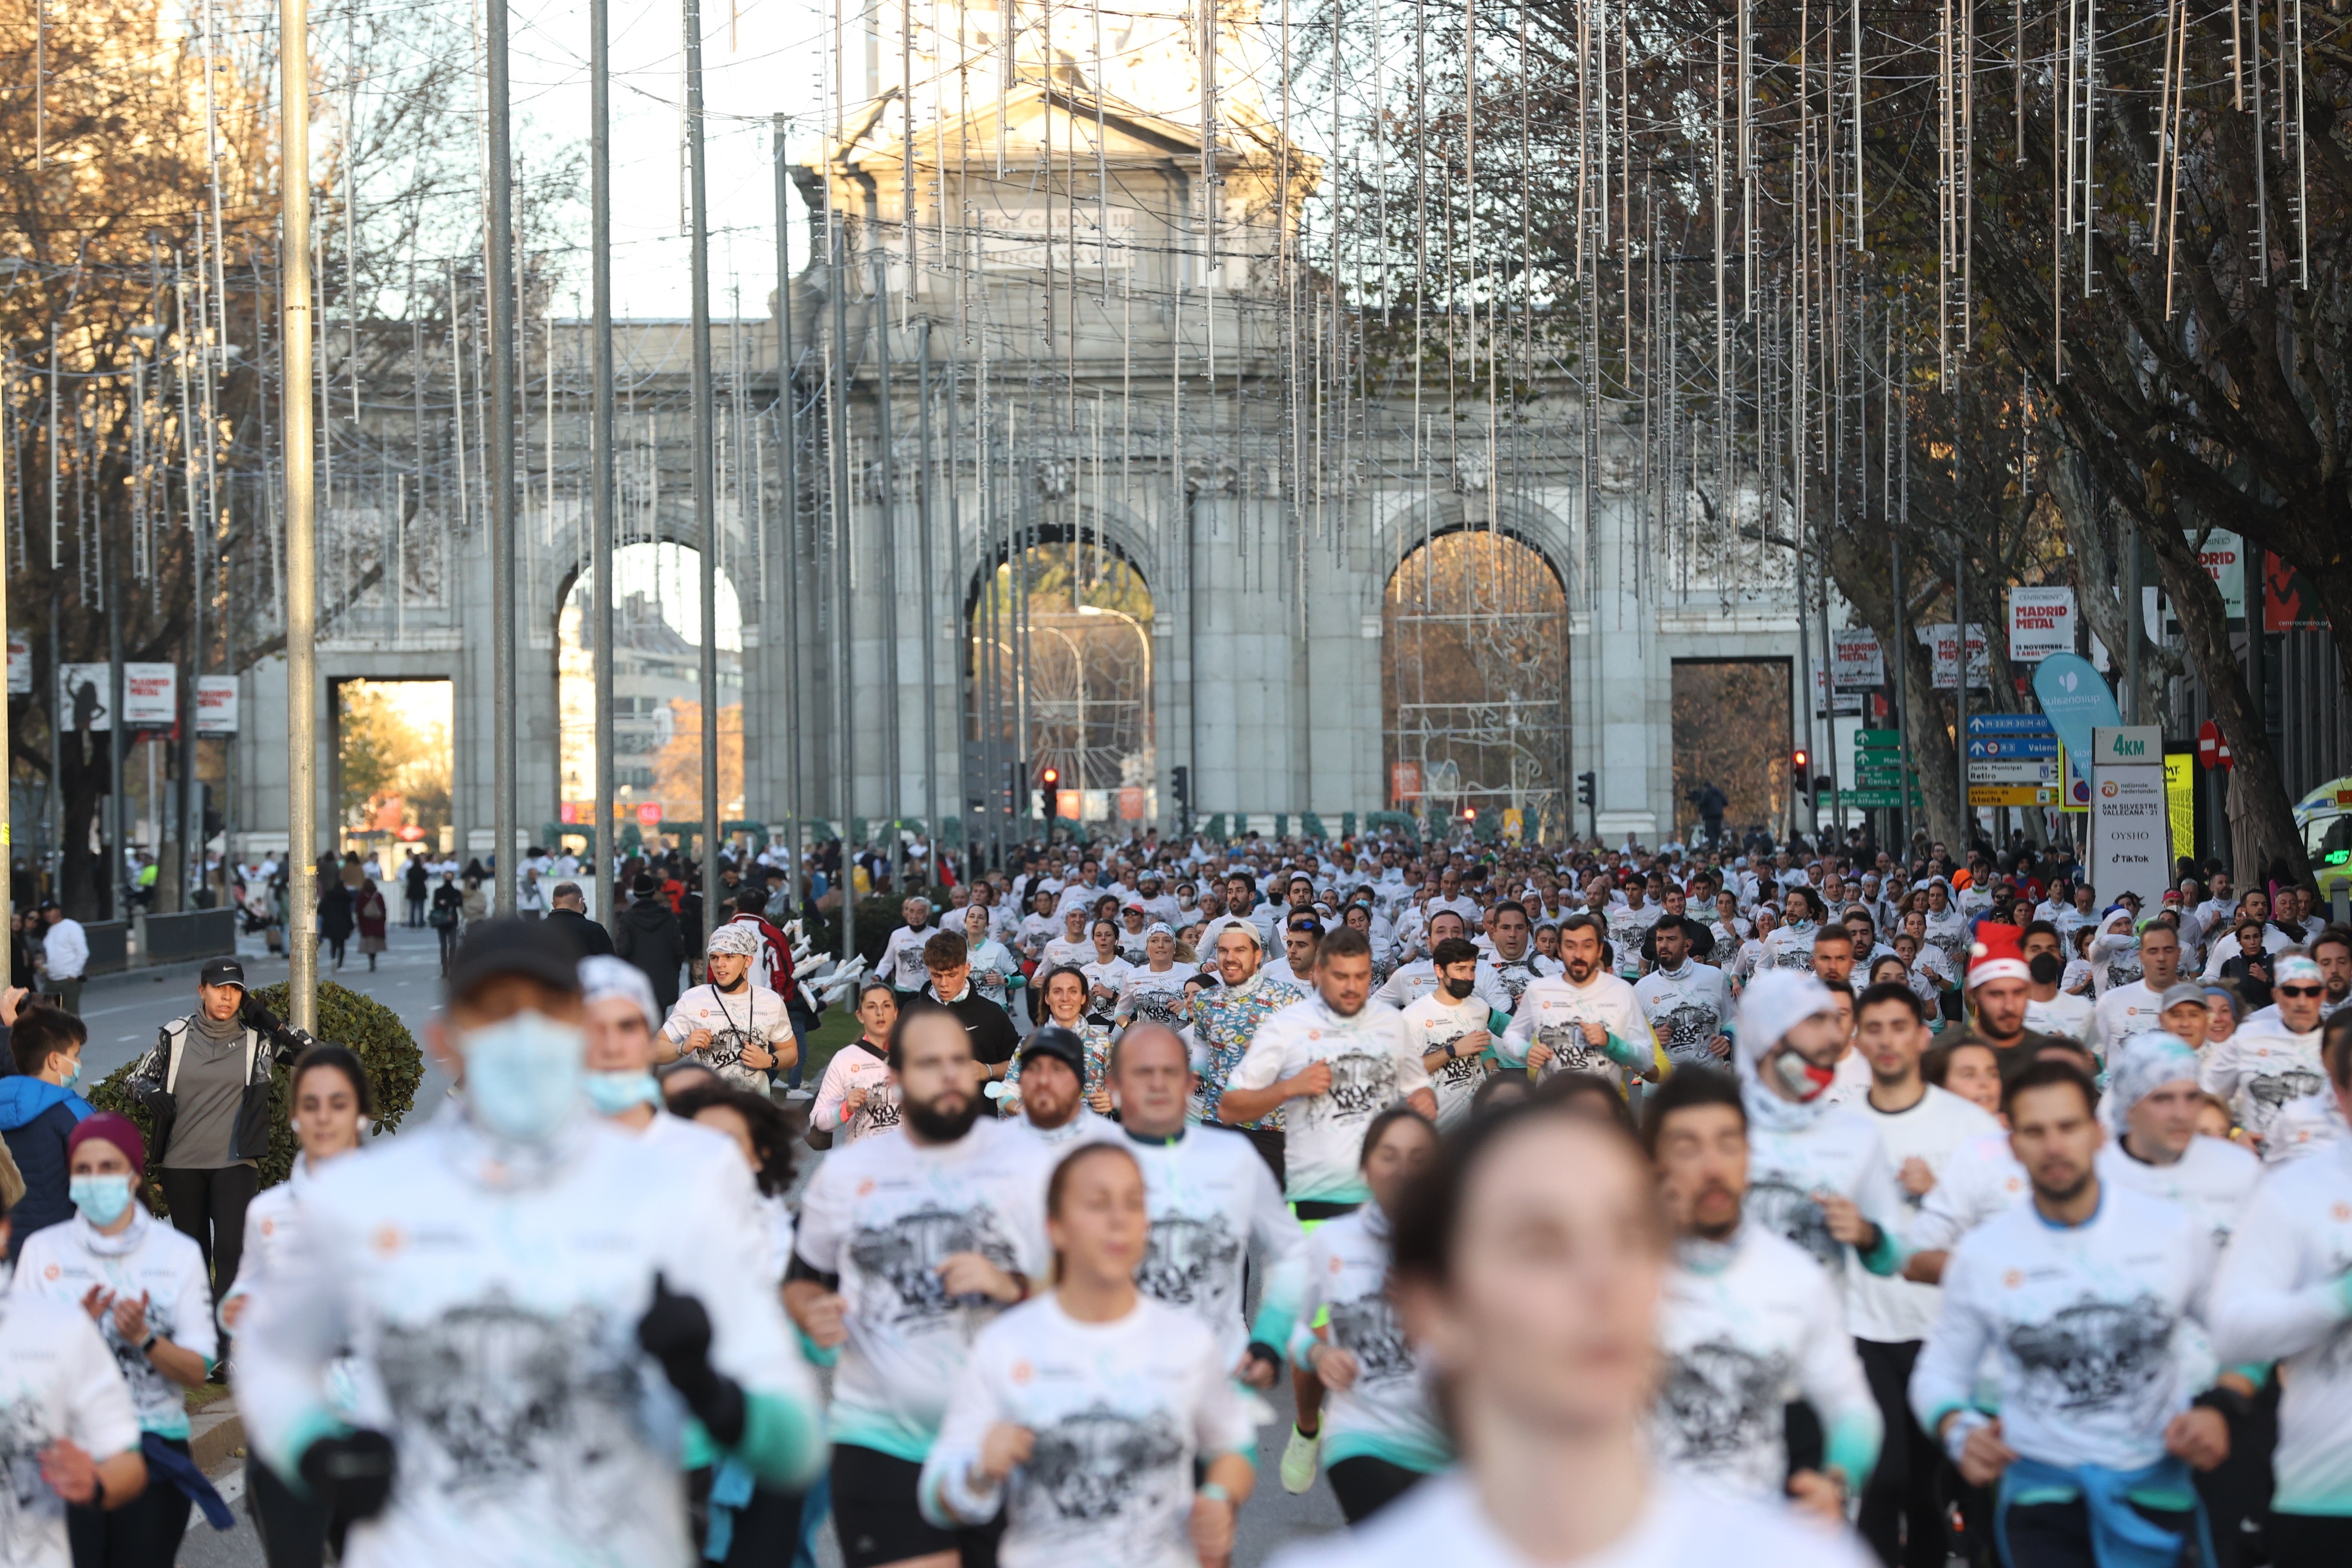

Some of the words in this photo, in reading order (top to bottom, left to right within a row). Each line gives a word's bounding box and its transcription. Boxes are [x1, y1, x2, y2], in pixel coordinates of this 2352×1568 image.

[2198, 552, 2236, 564] DRID
[2016, 606, 2067, 617] MADRID
[2016, 618, 2055, 629] METAL
[1838, 643, 1878, 652] MADRID
[1938, 639, 1983, 650] MARID
[1838, 653, 1868, 662] METAL
[1857, 796, 1886, 805] Alfonso
[2111, 831, 2149, 840] OYSHO
[2122, 854, 2149, 863] TikTok
[1447, 1067, 1472, 1079] MOS
[867, 1104, 899, 1117] VOLV
[873, 1115, 900, 1124] MOS
